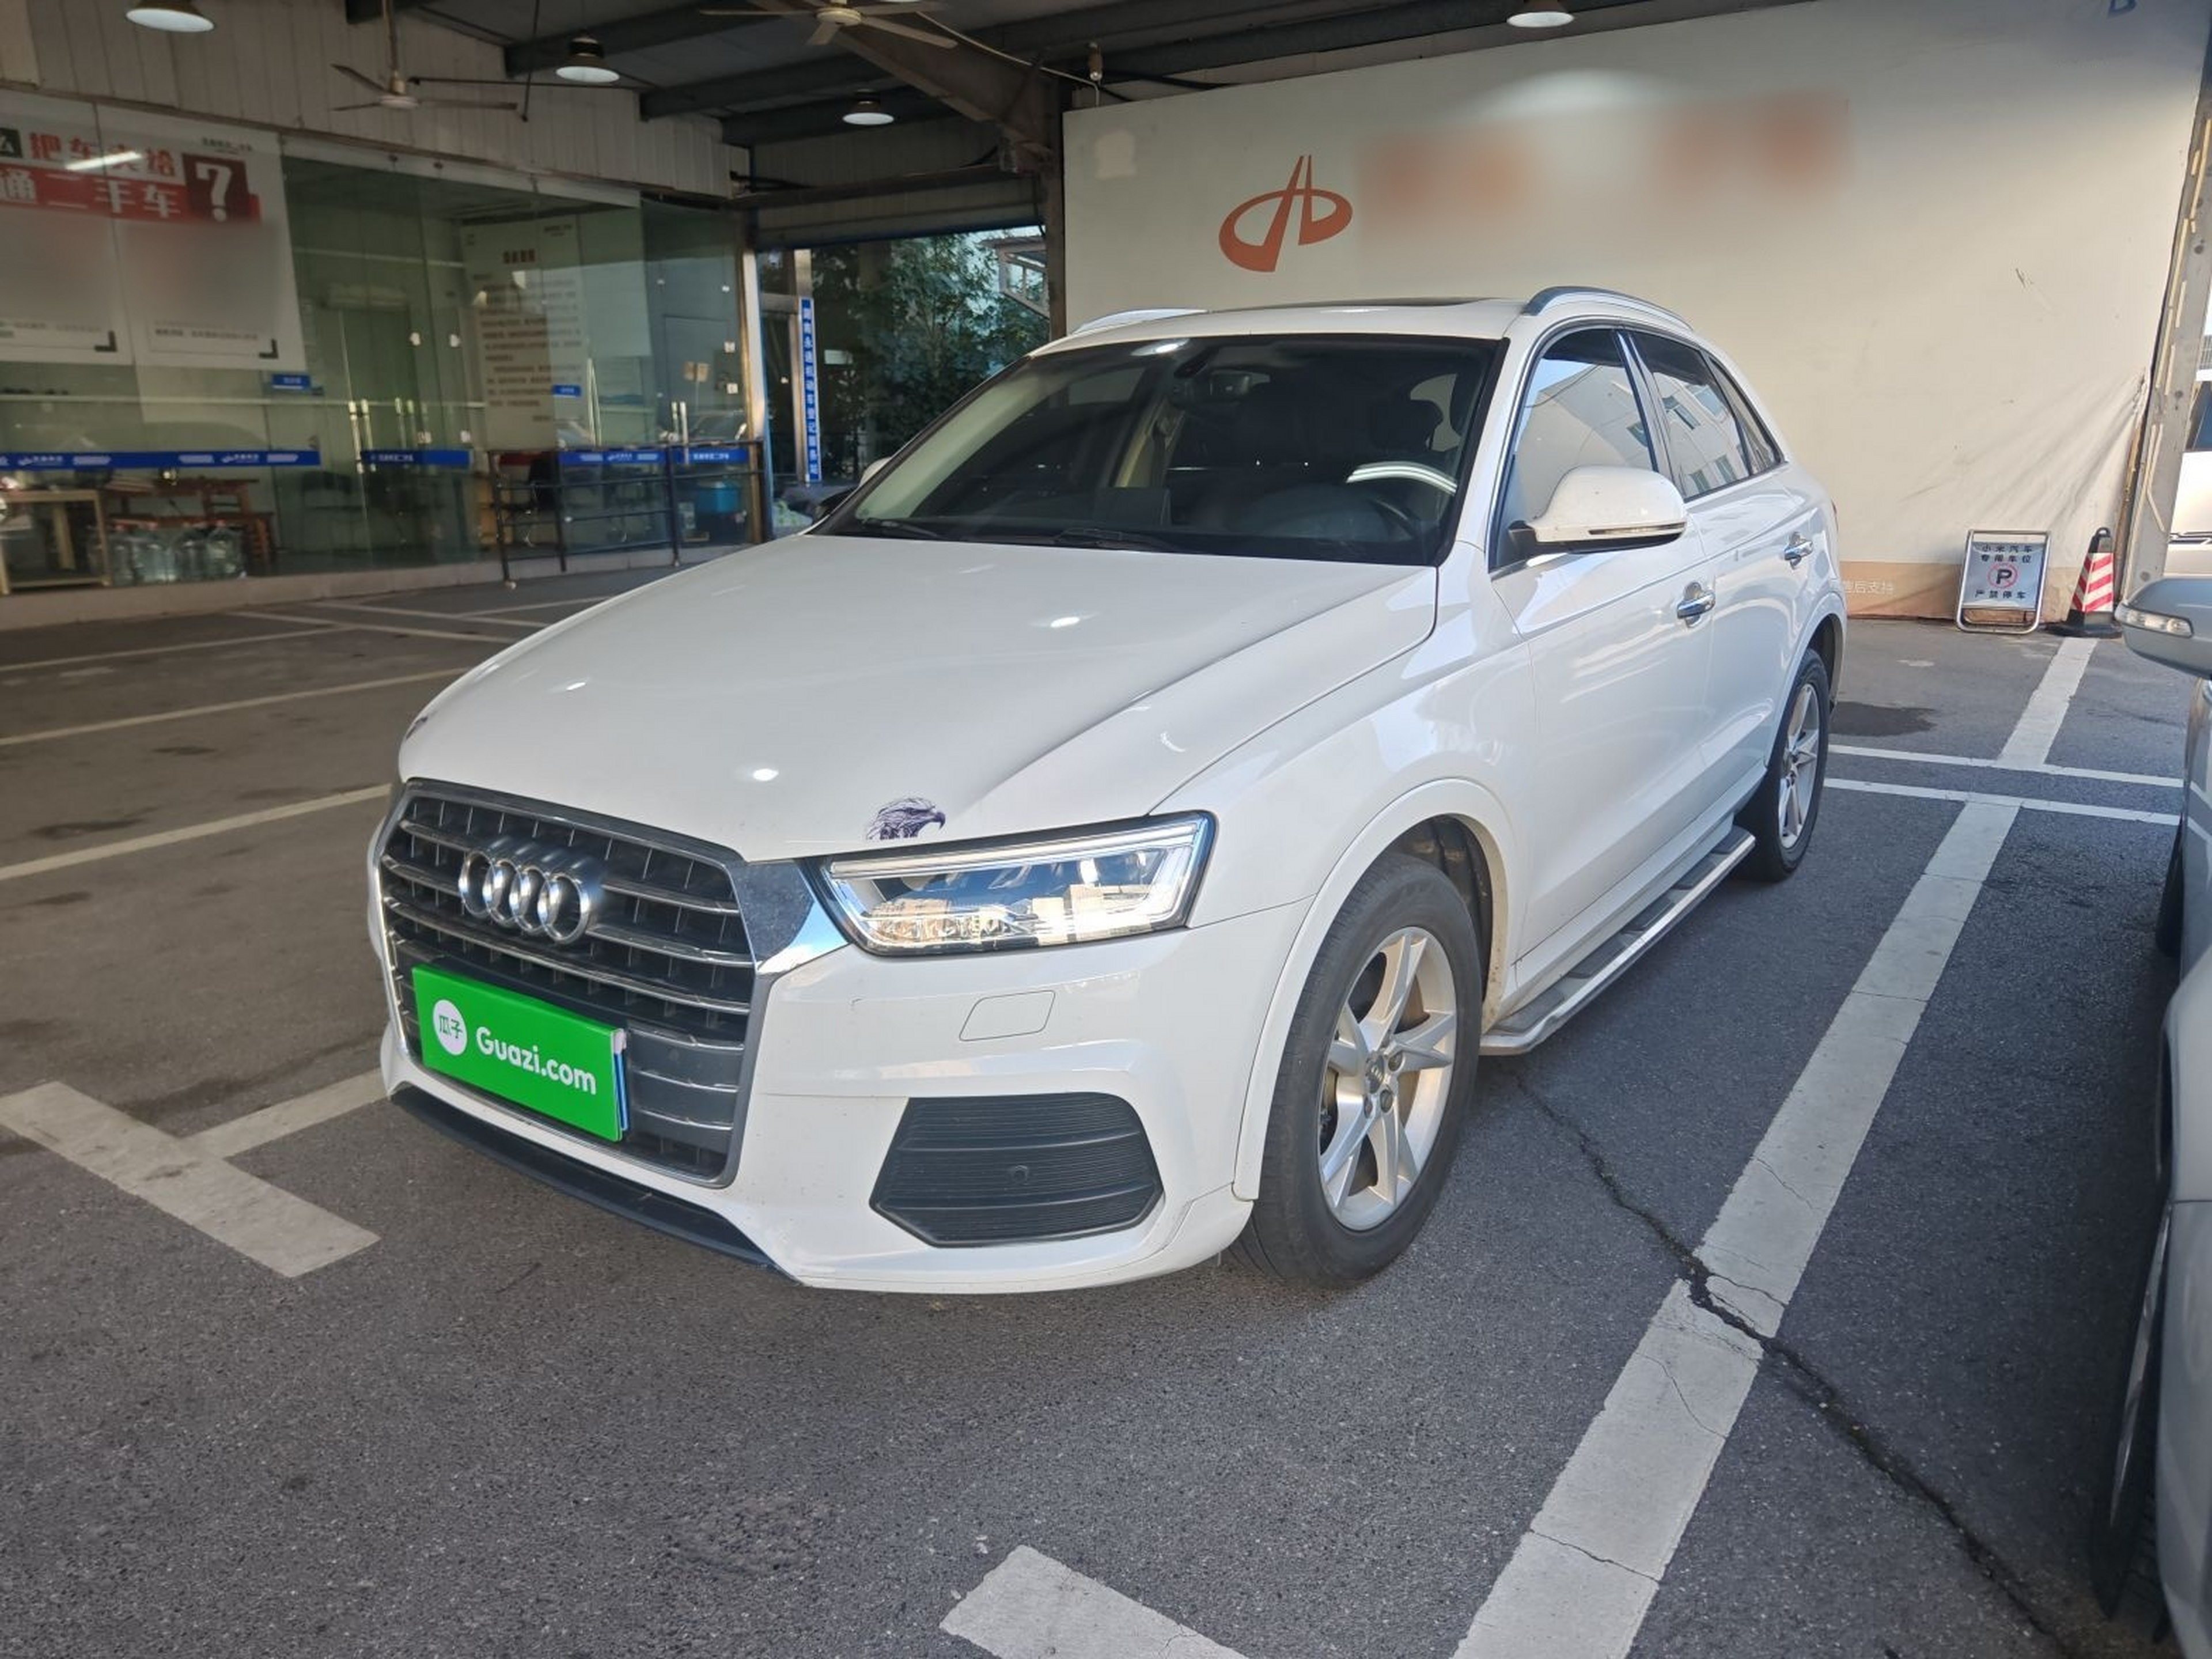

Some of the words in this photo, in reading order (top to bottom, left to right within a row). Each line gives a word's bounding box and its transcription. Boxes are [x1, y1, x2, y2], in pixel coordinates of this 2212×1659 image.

[1982, 545, 2033, 553] 小米汽车
[1981, 554, 2032, 563] 专用车位
[1996, 569, 2013, 585] P
[1975, 589, 2027, 599] 严禁停车
[438, 1014, 463, 1039] 瓜子
[476, 1026, 597, 1096] Guazi.com
